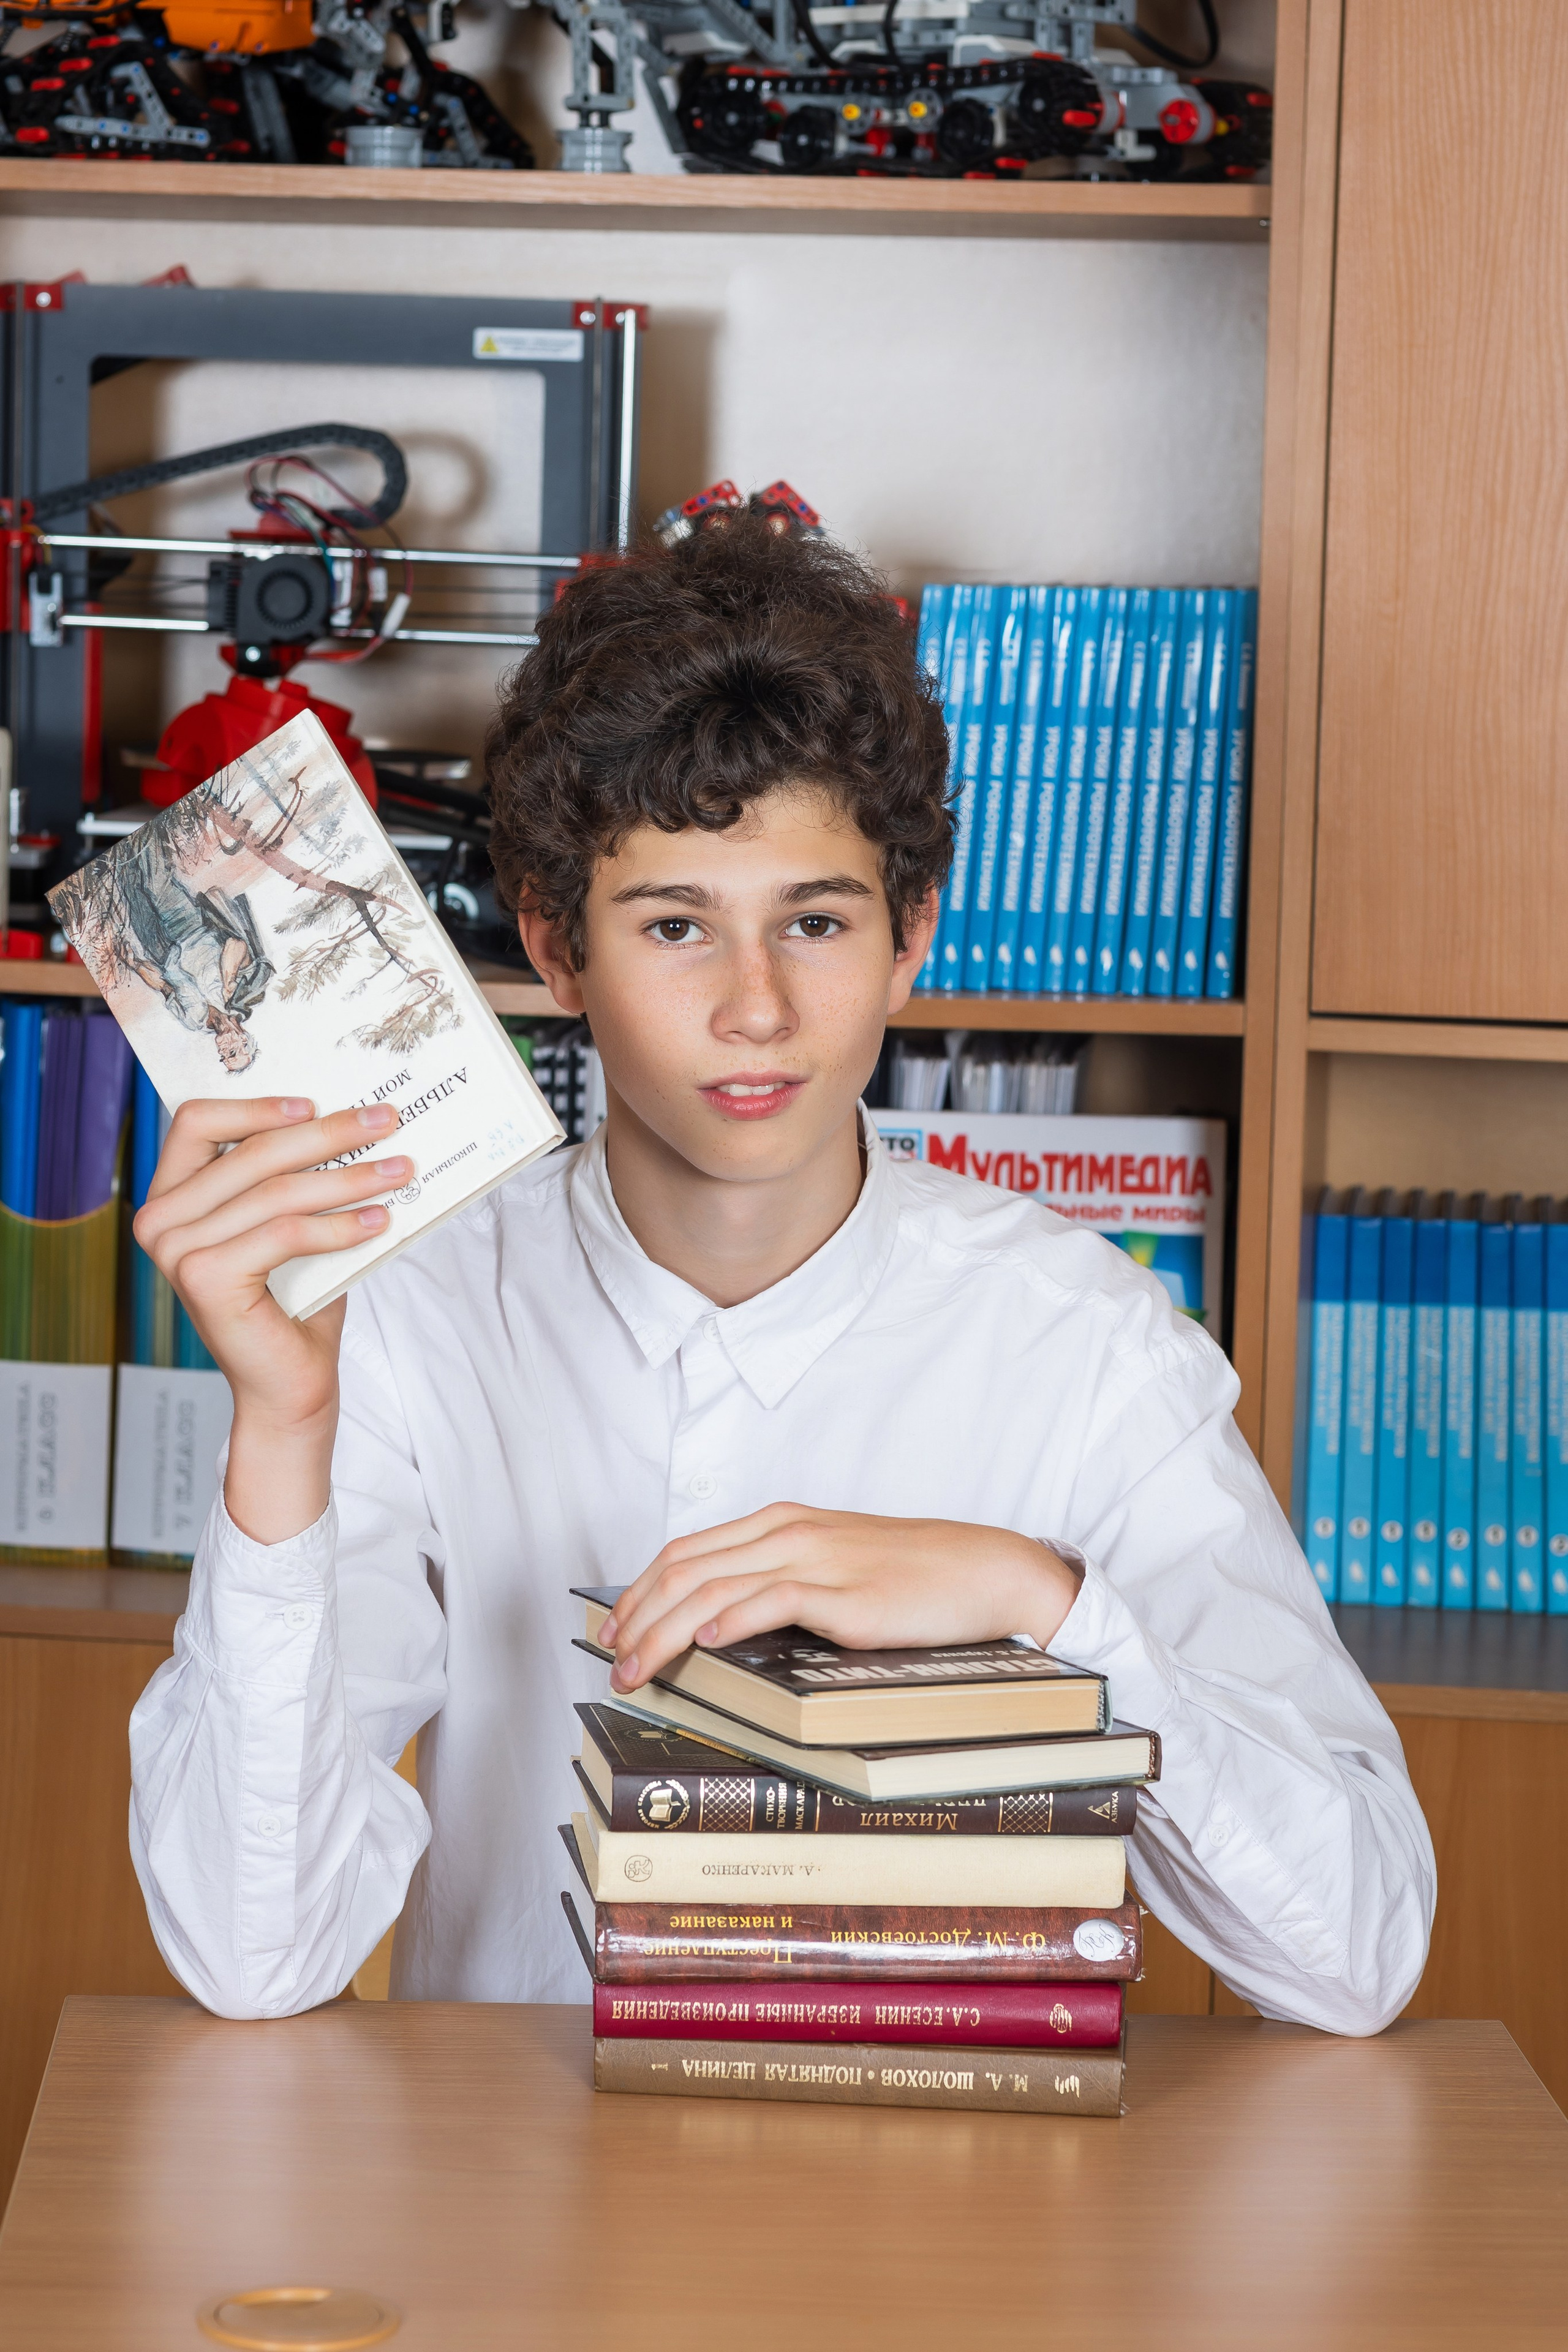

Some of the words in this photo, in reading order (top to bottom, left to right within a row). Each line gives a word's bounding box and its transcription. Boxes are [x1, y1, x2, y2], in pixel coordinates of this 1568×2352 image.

[372, 1068, 413, 1102] МОЙ
[880, 1137, 915, 1152] ТО
[422, 1142, 478, 1183] ШКОЛЬНАЯ
[791, 1659, 1060, 1682] СТАЛИН-ТИТО
[766, 1786, 775, 1822] СТИХО-
[777, 1782, 787, 1828] ТВОРЕНИЯ
[859, 1812, 959, 1831] Михаил
[701, 1863, 794, 1875] МАКАРЕНКО
[669, 1915, 774, 1929] наказание
[780, 1915, 792, 1928] и
[830, 1927, 971, 1949] Достоевский
[977, 1931, 1007, 1949] М.
[1015, 1931, 1045, 1951] Ф.
[643, 1937, 792, 1964] Преступление
[611, 1999, 748, 2021] ПРОИЗВЕДЕНИЯ
[755, 2002, 860, 2024] ИЗБРАННЫЕ
[680, 2058, 756, 2079] ЦЕЛИНА
[764, 2062, 862, 2085] ПОДНЯТАЯ
[880, 2068, 973, 2089] ШОЛОХОВ
[984, 2071, 1003, 2090] А.
[1008, 2072, 1028, 2092] М.
